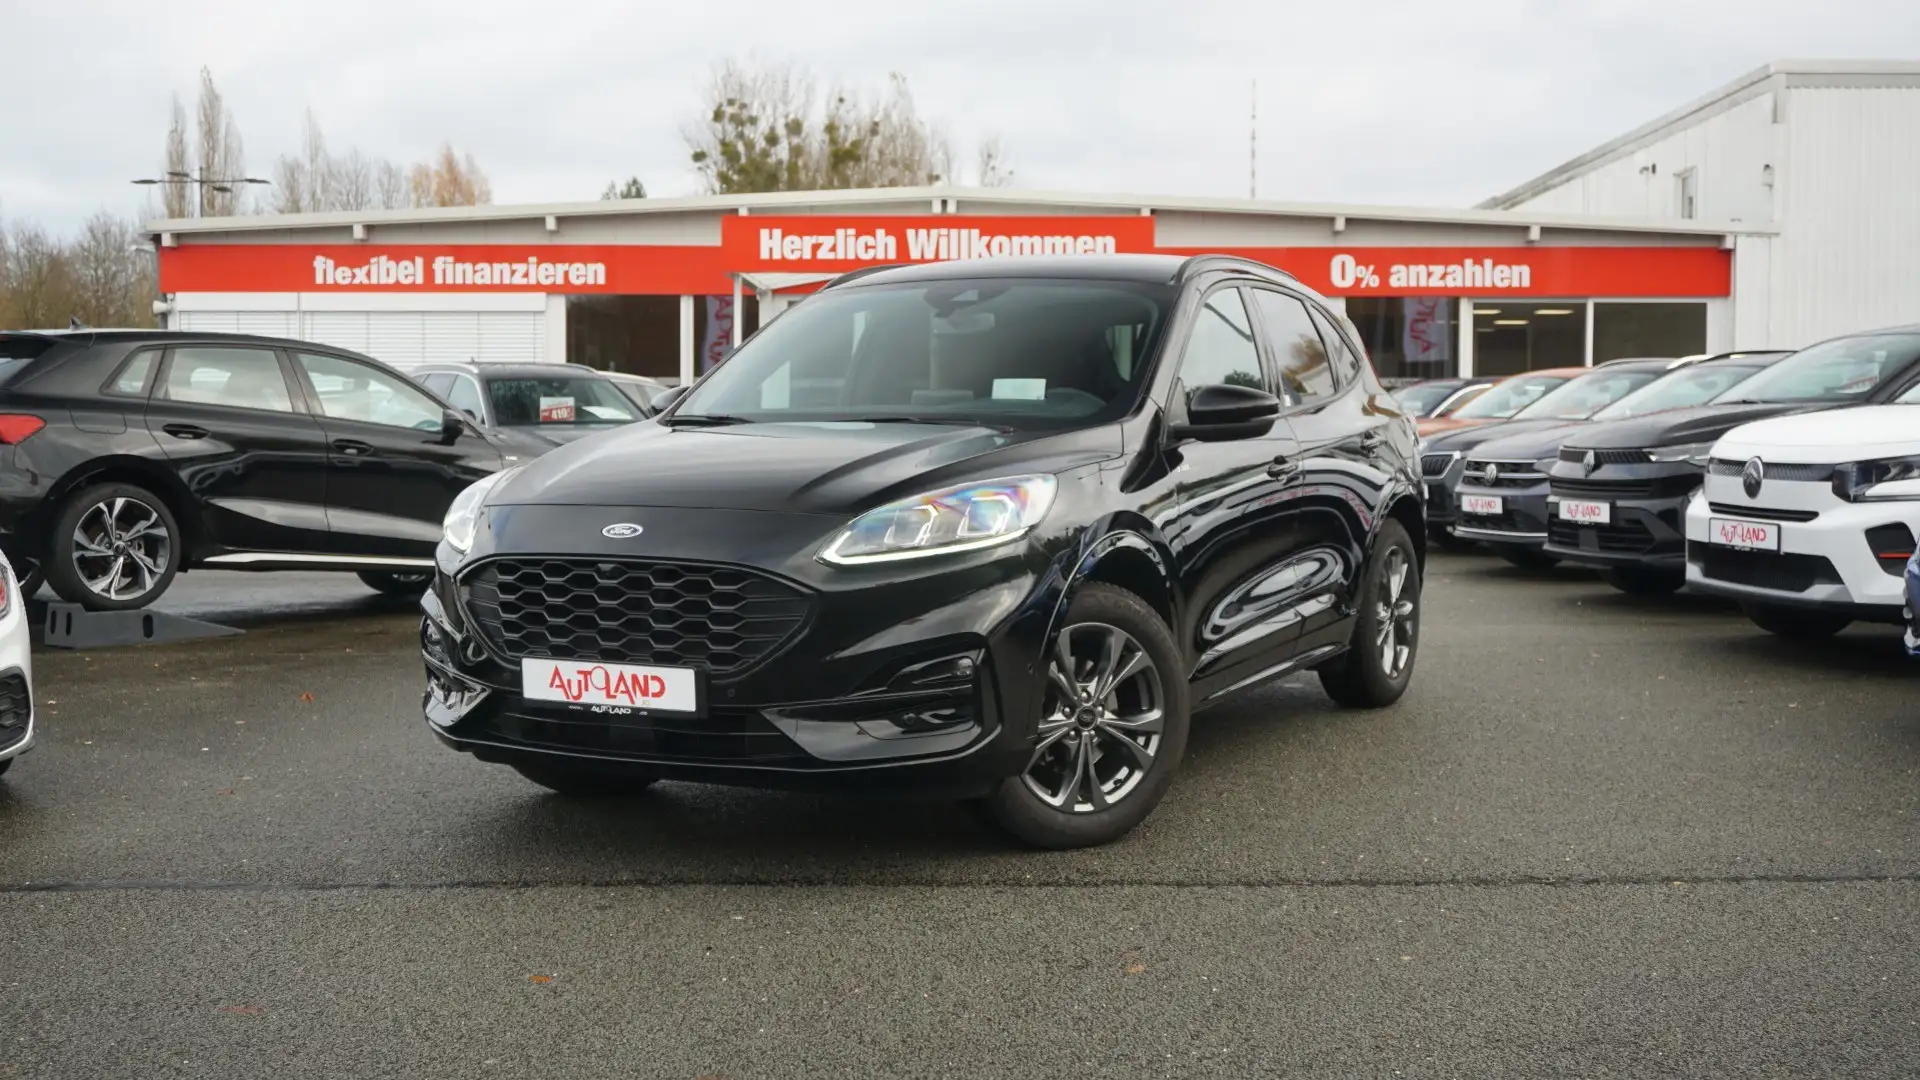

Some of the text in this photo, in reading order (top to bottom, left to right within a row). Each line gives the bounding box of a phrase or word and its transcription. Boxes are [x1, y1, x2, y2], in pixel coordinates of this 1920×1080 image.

[759, 228, 1116, 260] Herzlich Willkommen
[313, 254, 606, 286] flexibel finanzieren
[1330, 253, 1531, 288] 0% anzahlen
[1720, 522, 1767, 545] AUTOLAND
[549, 664, 667, 705] AUTOLAND
[591, 705, 632, 715] AUTOLAND
